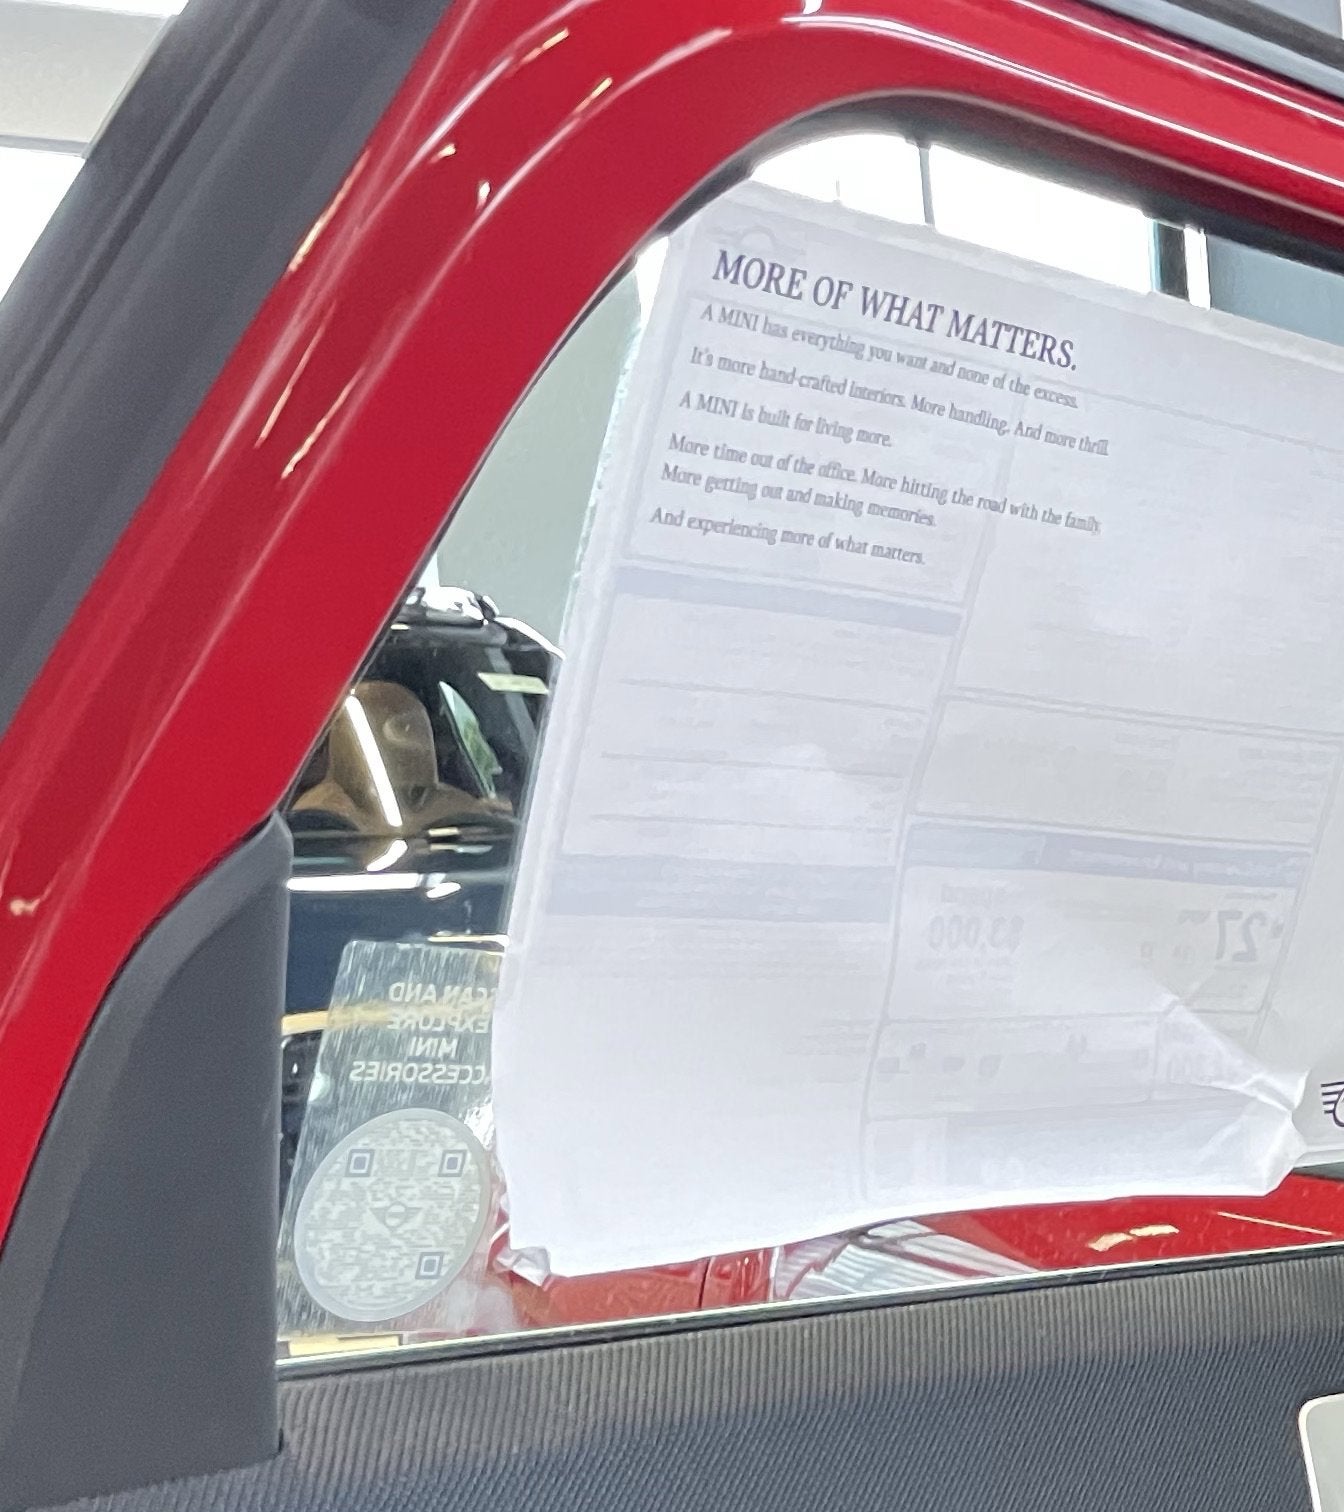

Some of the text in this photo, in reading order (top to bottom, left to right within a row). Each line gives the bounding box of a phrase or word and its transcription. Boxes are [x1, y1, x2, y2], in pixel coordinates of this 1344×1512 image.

[700, 304, 713, 321] A
[718, 306, 759, 331] MINI
[762, 315, 788, 338] has
[792, 328, 865, 361] everything
[867, 345, 892, 362] you
[897, 351, 928, 370] want
[930, 360, 956, 377] and
[957, 366, 989, 385] none
[993, 373, 1007, 389] of
[1009, 376, 1030, 396] the
[712, 249, 1077, 371] MORE OF WHAT MATTERS.
[679, 390, 892, 447] A MINI is built for living more.
[690, 346, 713, 366] It's
[717, 356, 756, 376] more
[759, 360, 847, 395] hand-crafted
[911, 394, 945, 417] More
[949, 403, 1010, 436] handling.
[1014, 420, 1042, 440] And
[1044, 430, 1076, 449] more
[661, 462, 936, 527] More getting out and making memories.
[668, 432, 709, 456] More
[713, 443, 748, 463] time
[751, 452, 773, 468] out
[776, 454, 793, 471] of
[793, 456, 815, 475] the
[861, 468, 897, 490] More
[900, 476, 948, 505] hitting
[951, 487, 973, 506] the
[977, 498, 1008, 514] road
[1010, 502, 1038, 520] with
[1041, 507, 1062, 525] the
[649, 507, 925, 565] And experiencing more of what matters.
